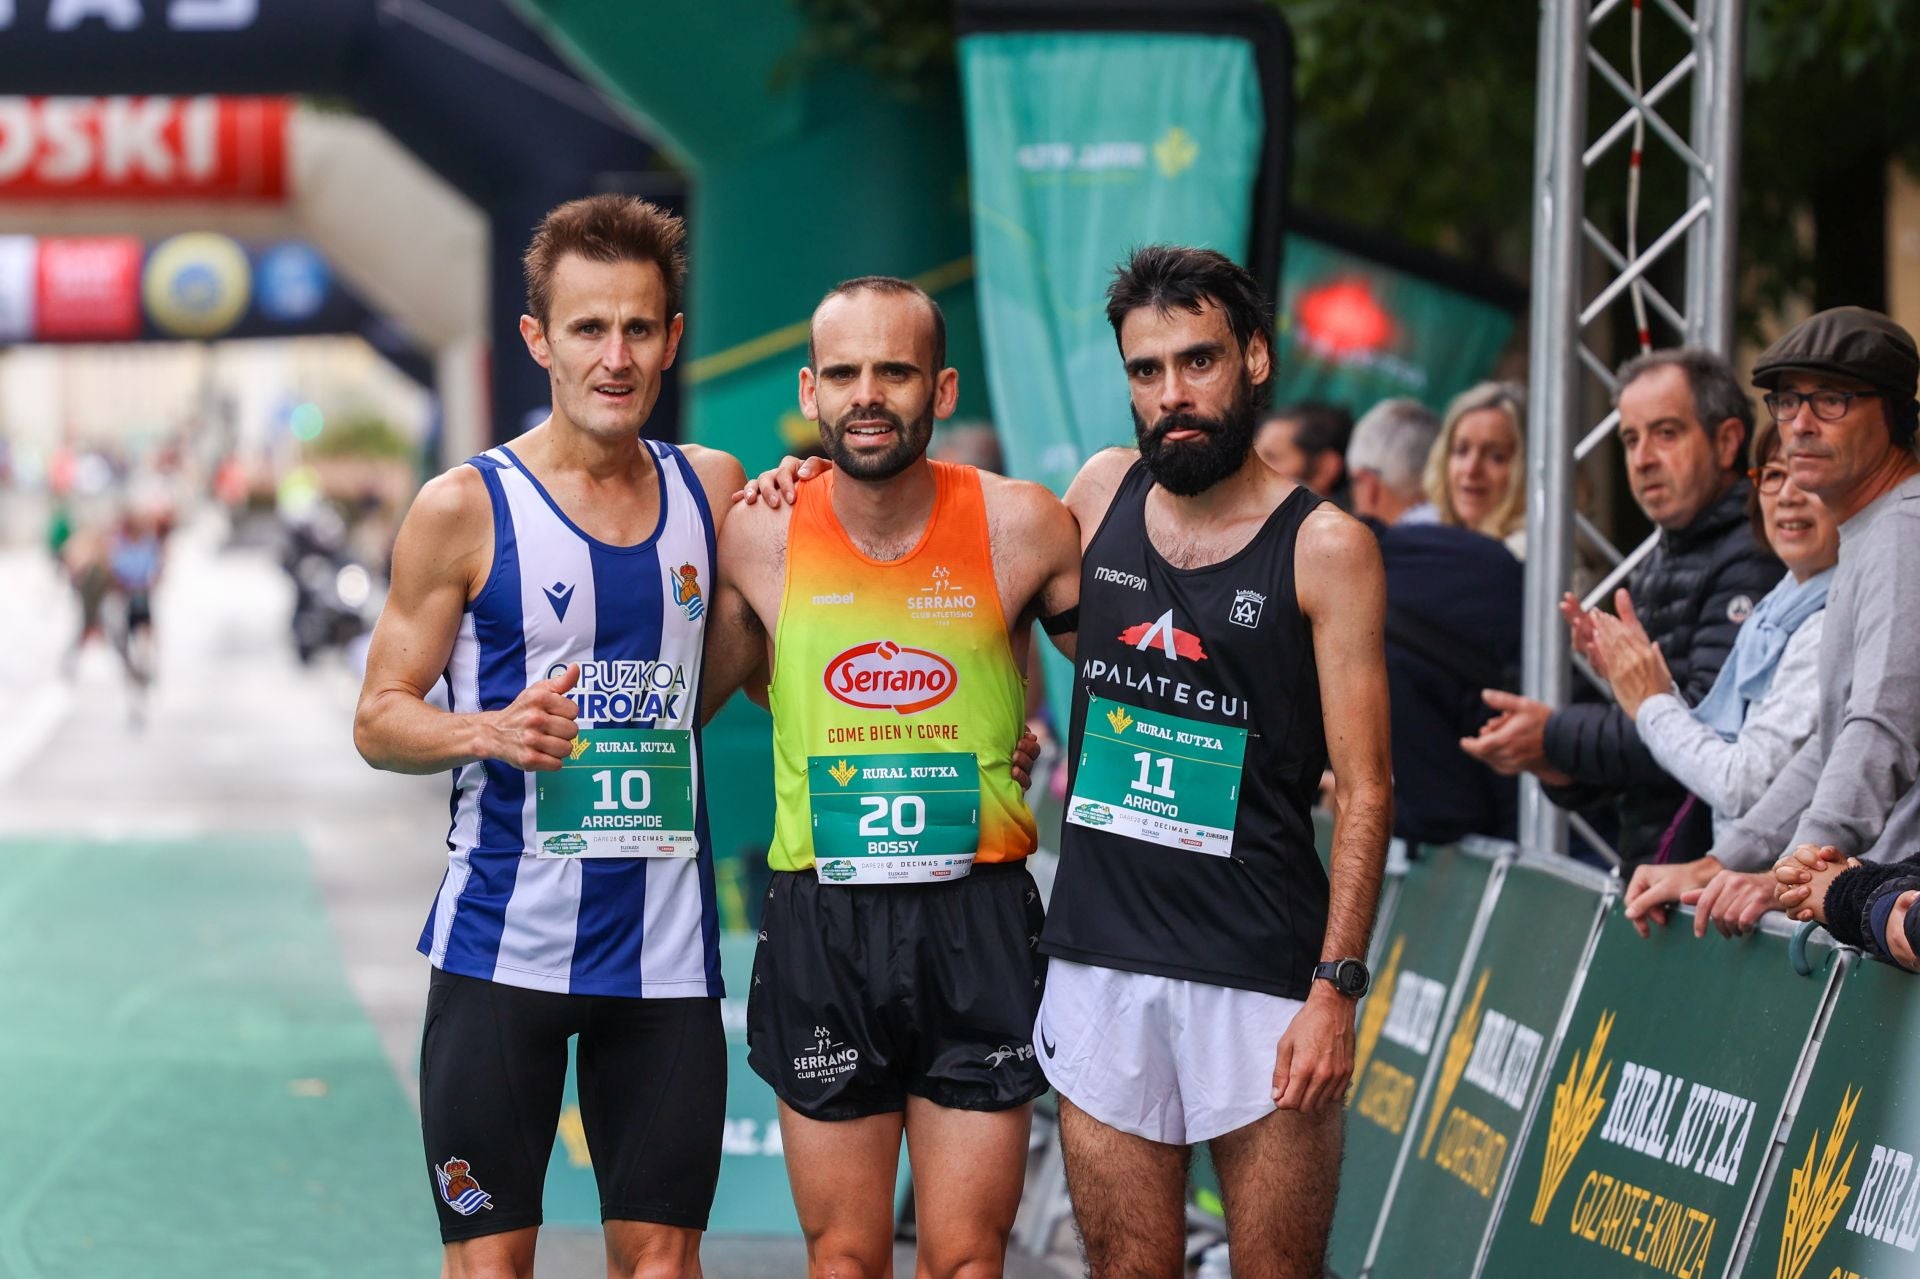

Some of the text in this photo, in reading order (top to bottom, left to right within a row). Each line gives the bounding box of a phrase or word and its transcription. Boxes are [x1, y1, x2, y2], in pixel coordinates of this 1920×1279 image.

[1094, 566, 1147, 592] macron
[812, 592, 854, 605] mobel
[907, 595, 976, 609] SERRANO
[838, 662, 946, 693] Serrano
[1083, 659, 1248, 720] APALATEGUI
[566, 693, 680, 719] IROLAK
[828, 725, 958, 743] COME BIEN Y CORRE
[1136, 721, 1223, 750] RURAL KUTXA
[596, 742, 676, 753] RURAL KUTXA
[863, 766, 959, 780] RURAL KUTXA
[1130, 752, 1175, 799] 11
[592, 770, 651, 810] 10
[859, 795, 926, 837] 20
[1122, 793, 1179, 818] ARROYO
[581, 815, 663, 828] ARROSPIDE
[1154, 822, 1189, 835] DECIMAS
[868, 841, 918, 855] BOSSY
[794, 1049, 859, 1070] SERRANO
[797, 1063, 857, 1079] CLUB ATLETISMO
[1600, 1061, 1684, 1159] RURAL
[1666, 1083, 1757, 1186] KUTXA
[1571, 1170, 1716, 1279] GIZARTE EKINTZA
